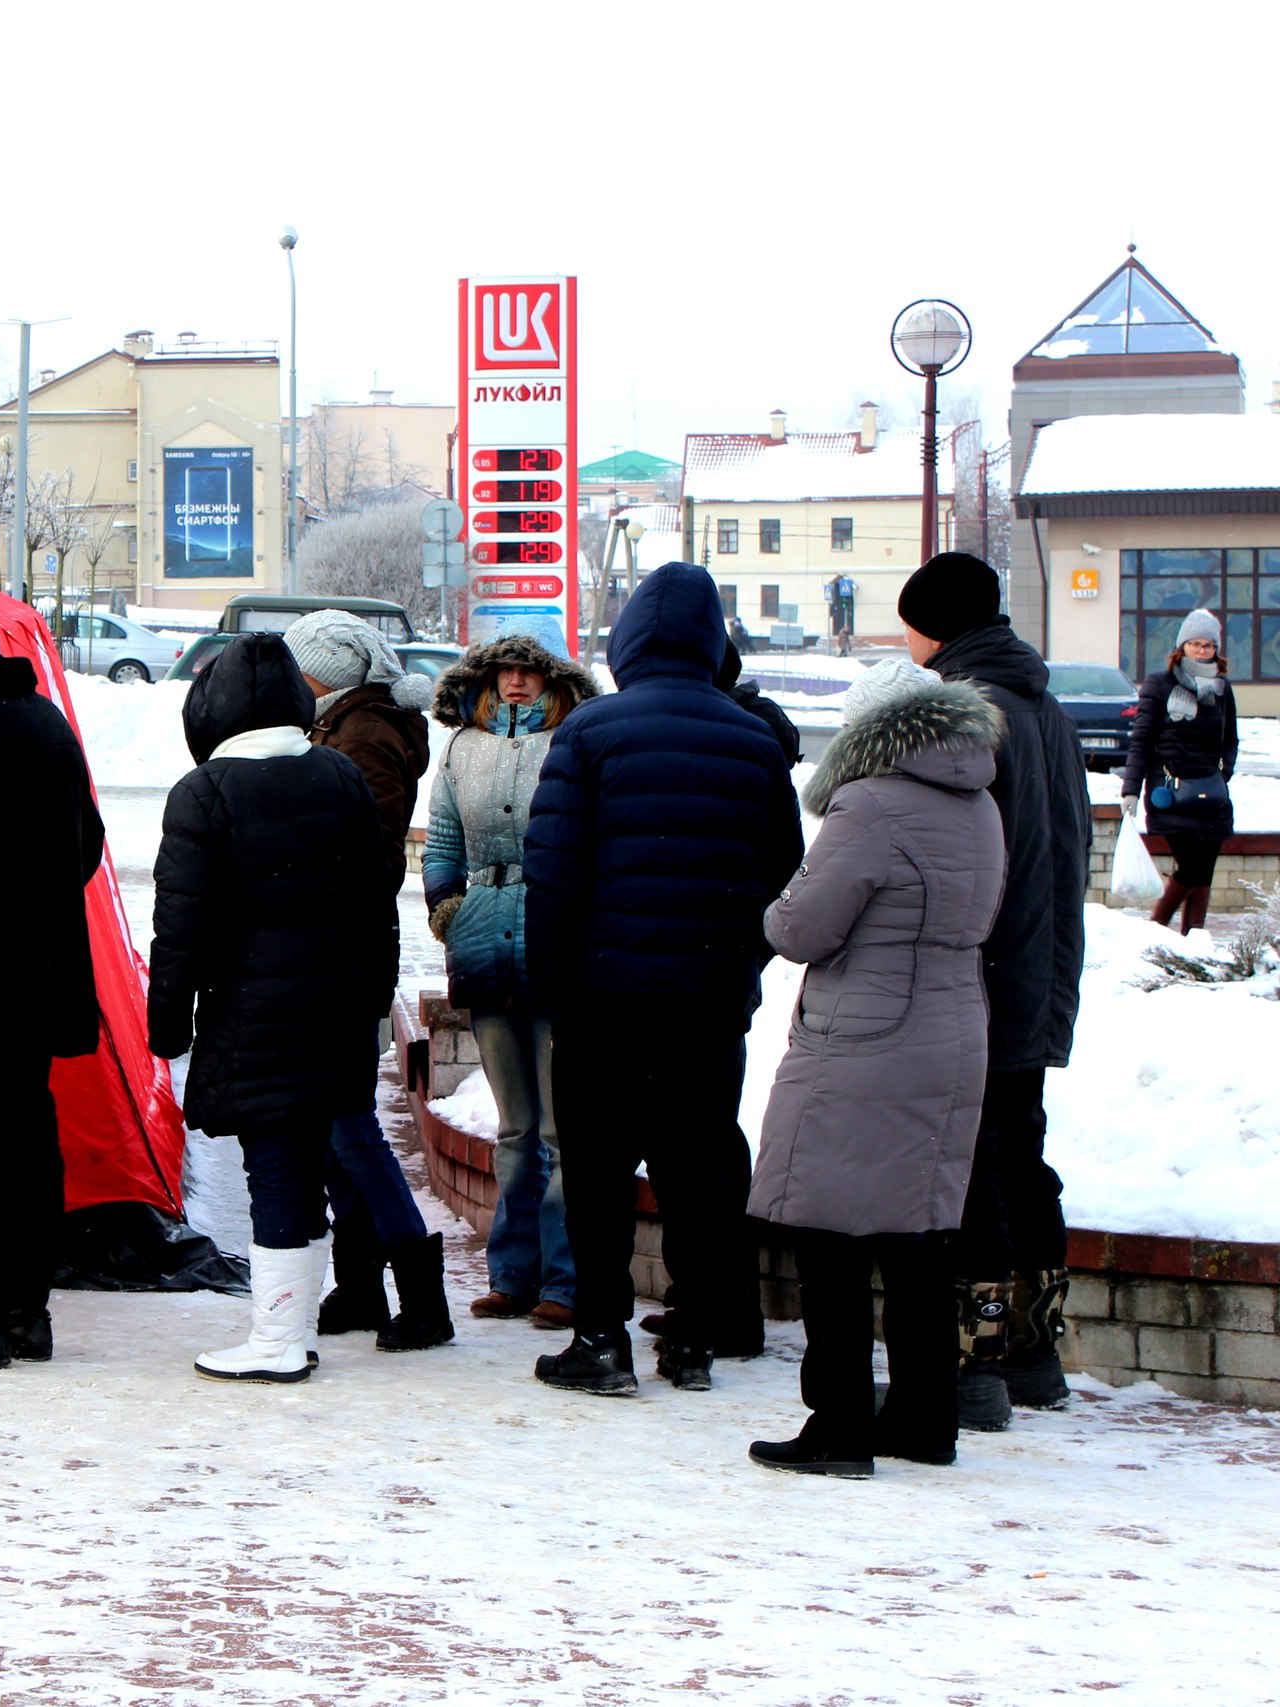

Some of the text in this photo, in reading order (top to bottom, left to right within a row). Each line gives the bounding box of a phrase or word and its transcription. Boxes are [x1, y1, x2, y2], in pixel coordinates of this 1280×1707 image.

[473, 382, 562, 402] ЛУКОЙЛ
[175, 503, 240, 514] БЯЗМЕЖНЫ
[176, 516, 238, 526] СМАРТФОН
